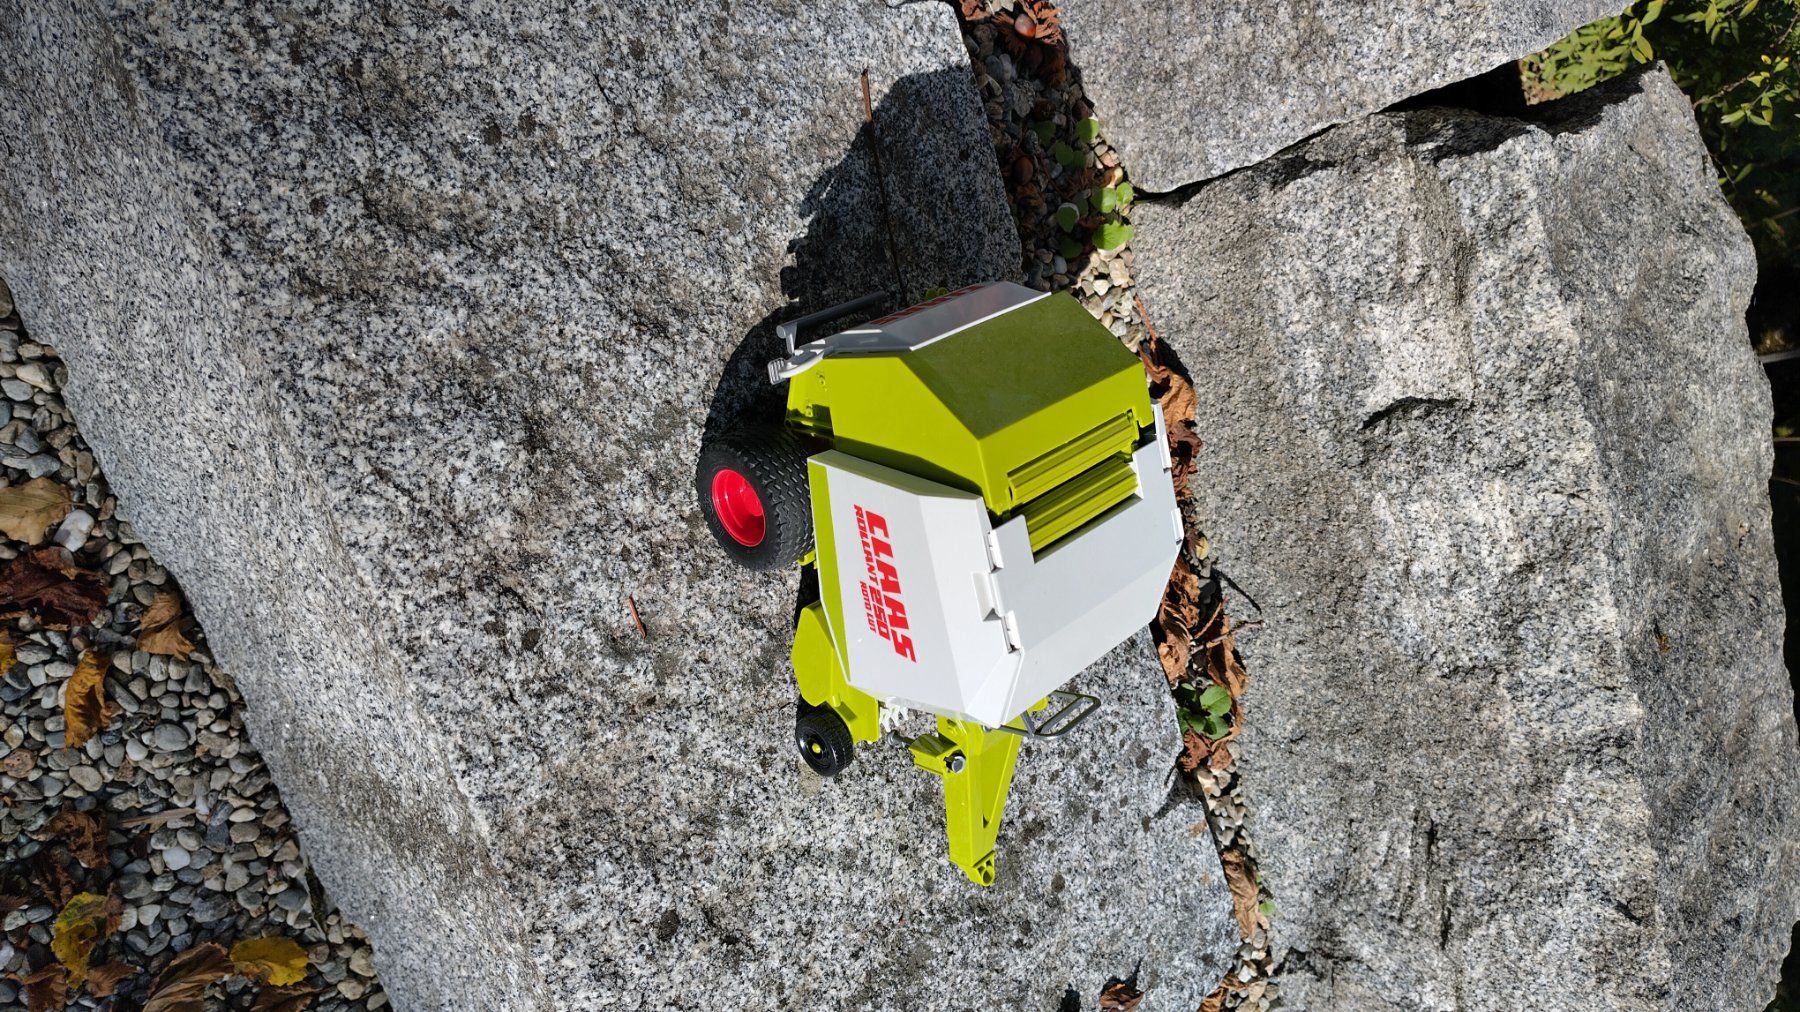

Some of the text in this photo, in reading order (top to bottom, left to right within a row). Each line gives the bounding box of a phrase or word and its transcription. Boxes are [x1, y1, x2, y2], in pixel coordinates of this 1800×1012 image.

[853, 504, 891, 641] ROLLANT 250
[859, 581, 877, 634] ROTO CUT
[865, 510, 917, 663] CLAAS
